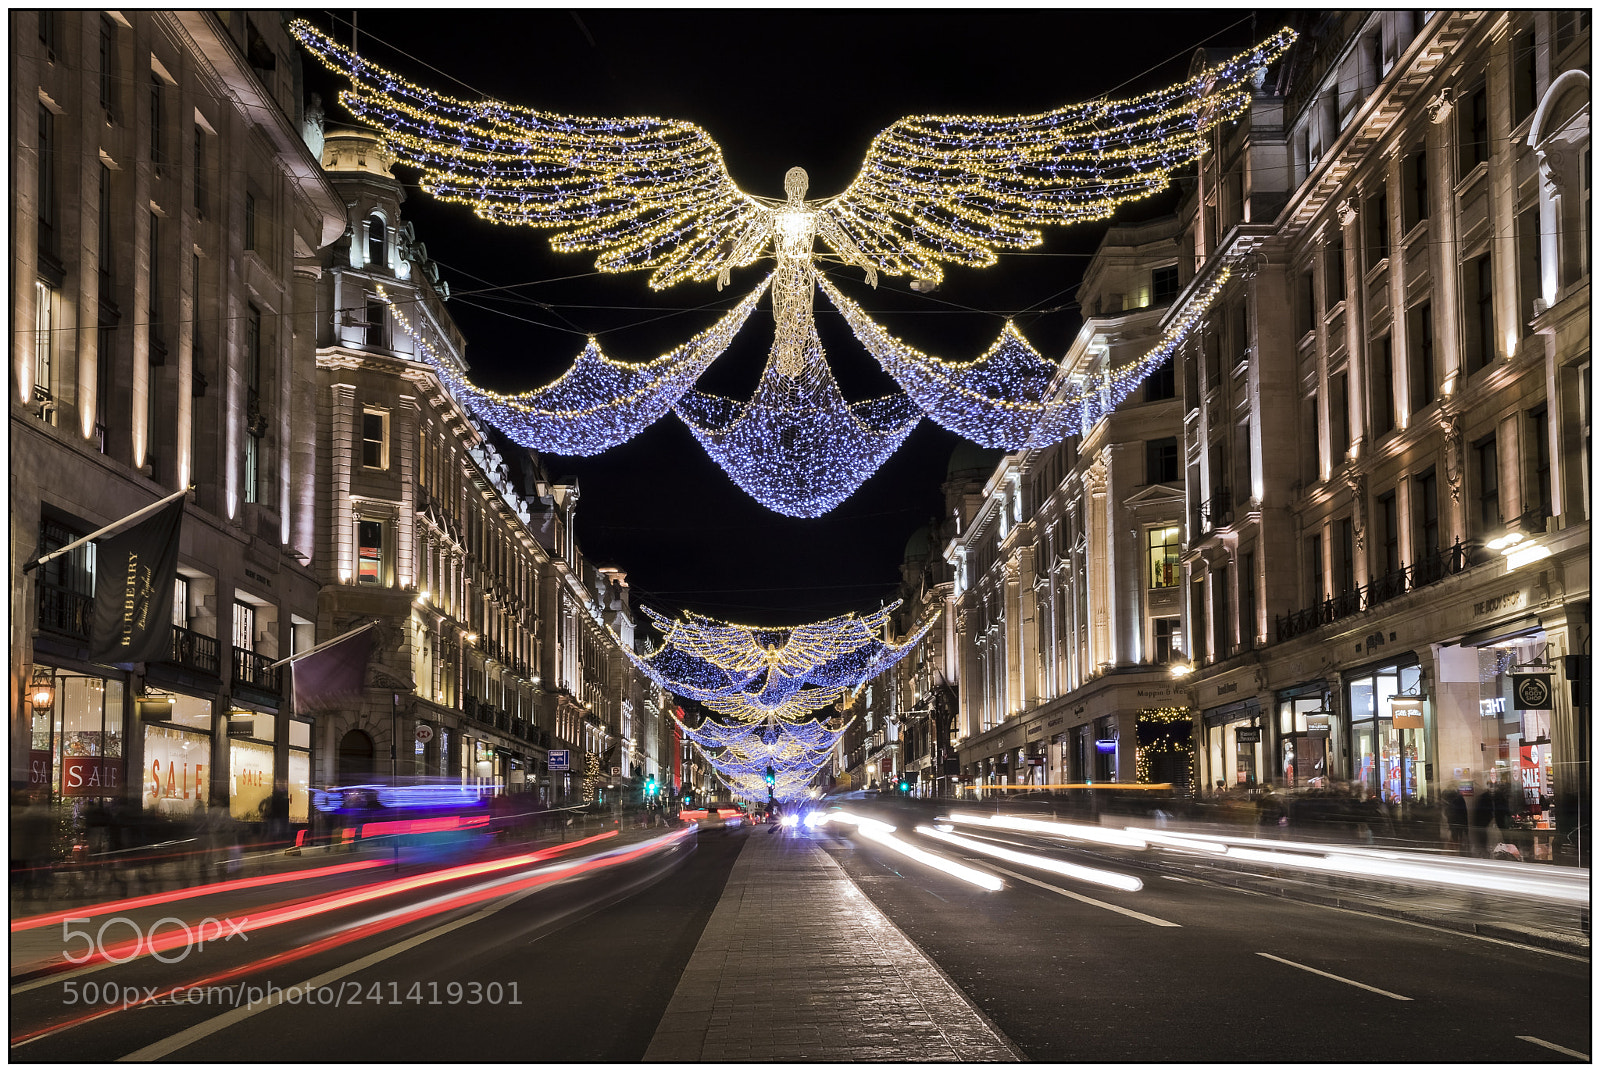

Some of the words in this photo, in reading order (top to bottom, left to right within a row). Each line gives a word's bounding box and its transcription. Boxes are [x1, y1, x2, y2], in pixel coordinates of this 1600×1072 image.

[121, 551, 139, 647] BURBERRY
[1473, 601, 1485, 617] THE
[1137, 689, 1164, 698] Mappin
[67, 765, 118, 788] SALE
[151, 758, 203, 801] SALE
[242, 768, 263, 788] SALE
[1521, 767, 1540, 788] SALE
